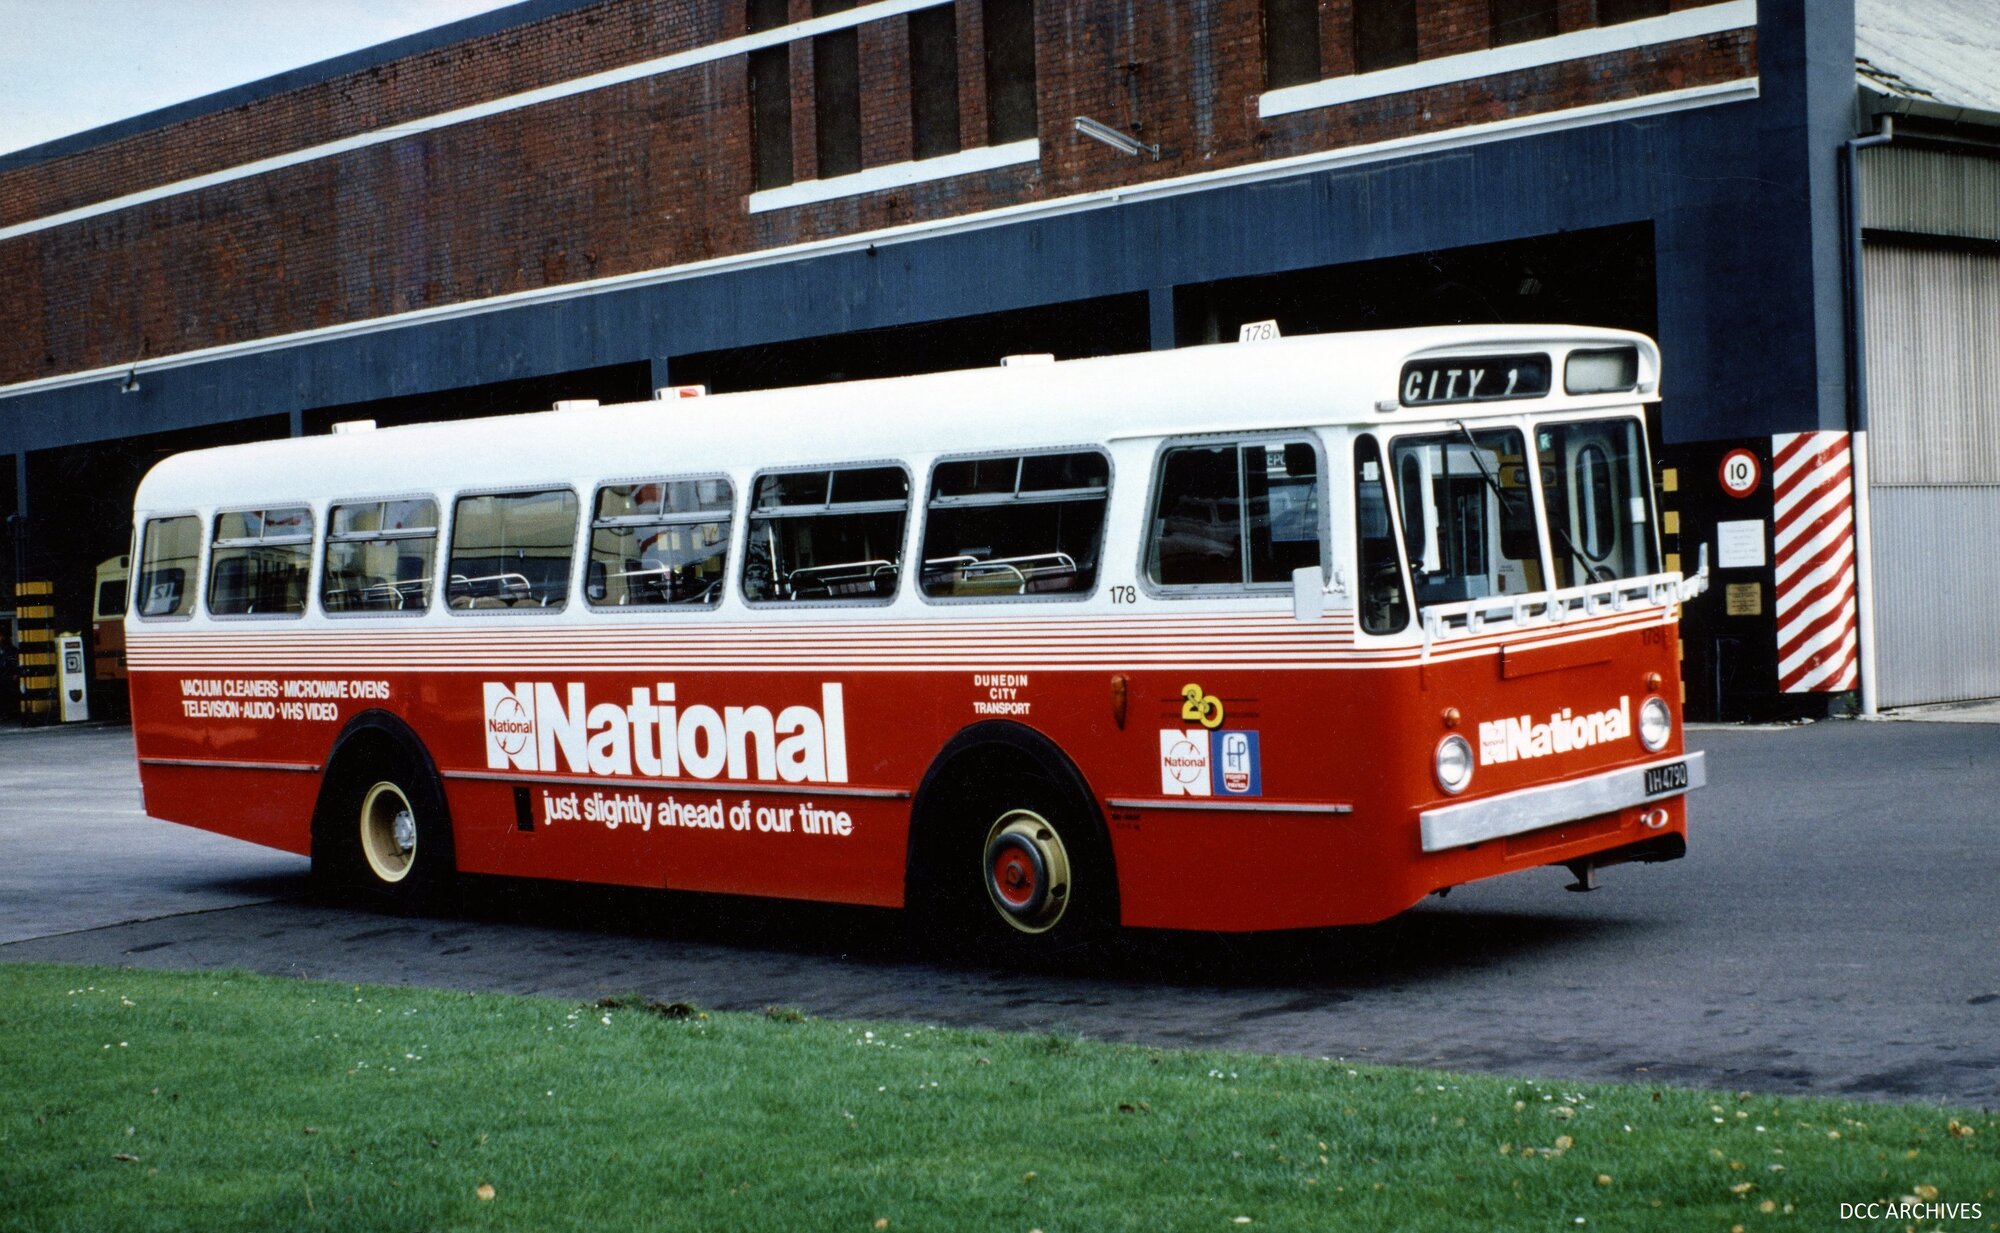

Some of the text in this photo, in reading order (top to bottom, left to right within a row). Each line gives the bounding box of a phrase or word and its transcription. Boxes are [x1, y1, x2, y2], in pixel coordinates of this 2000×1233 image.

[1245, 323, 1271, 342] 178
[1404, 368, 1485, 401] CITY
[1730, 463, 1748, 480] 10
[1109, 585, 1137, 604] 178
[181, 679, 390, 699] VACUUM CLEANERS MICROWAVE OVENS
[974, 674, 1028, 687] DUNEDIN
[989, 687, 1017, 700] CITY
[182, 700, 338, 721] TELEVISION AUDIO VHS VIDEO
[973, 701, 1031, 715] TRANSPORT
[1182, 683, 1223, 728] 20
[489, 719, 532, 734] National
[535, 682, 848, 783] National
[1506, 695, 1631, 761] National
[1164, 757, 1206, 767] National
[543, 790, 853, 836] just slightly ahead of our time
